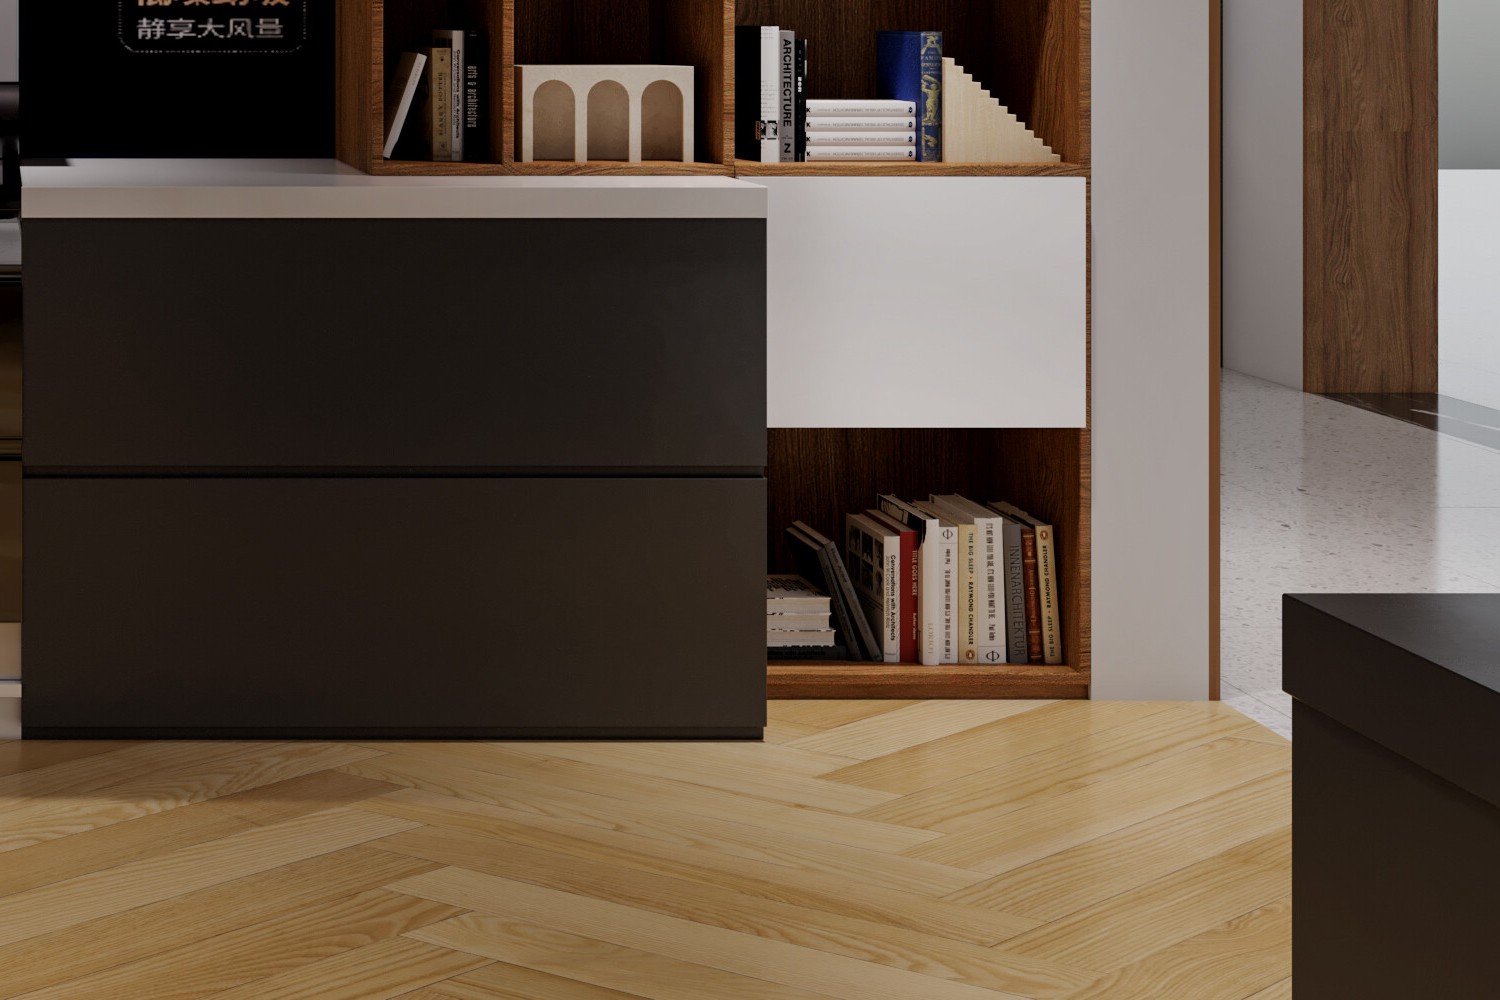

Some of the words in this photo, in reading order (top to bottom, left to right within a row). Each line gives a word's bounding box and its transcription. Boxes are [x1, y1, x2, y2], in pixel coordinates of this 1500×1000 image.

[136, 18, 284, 39] 静享大风量
[467, 65, 478, 78] arts
[783, 39, 792, 127] ARCHITECTURE
[467, 89, 478, 128] architecture
[1009, 545, 1026, 656] INNENARCHITEKTUR
